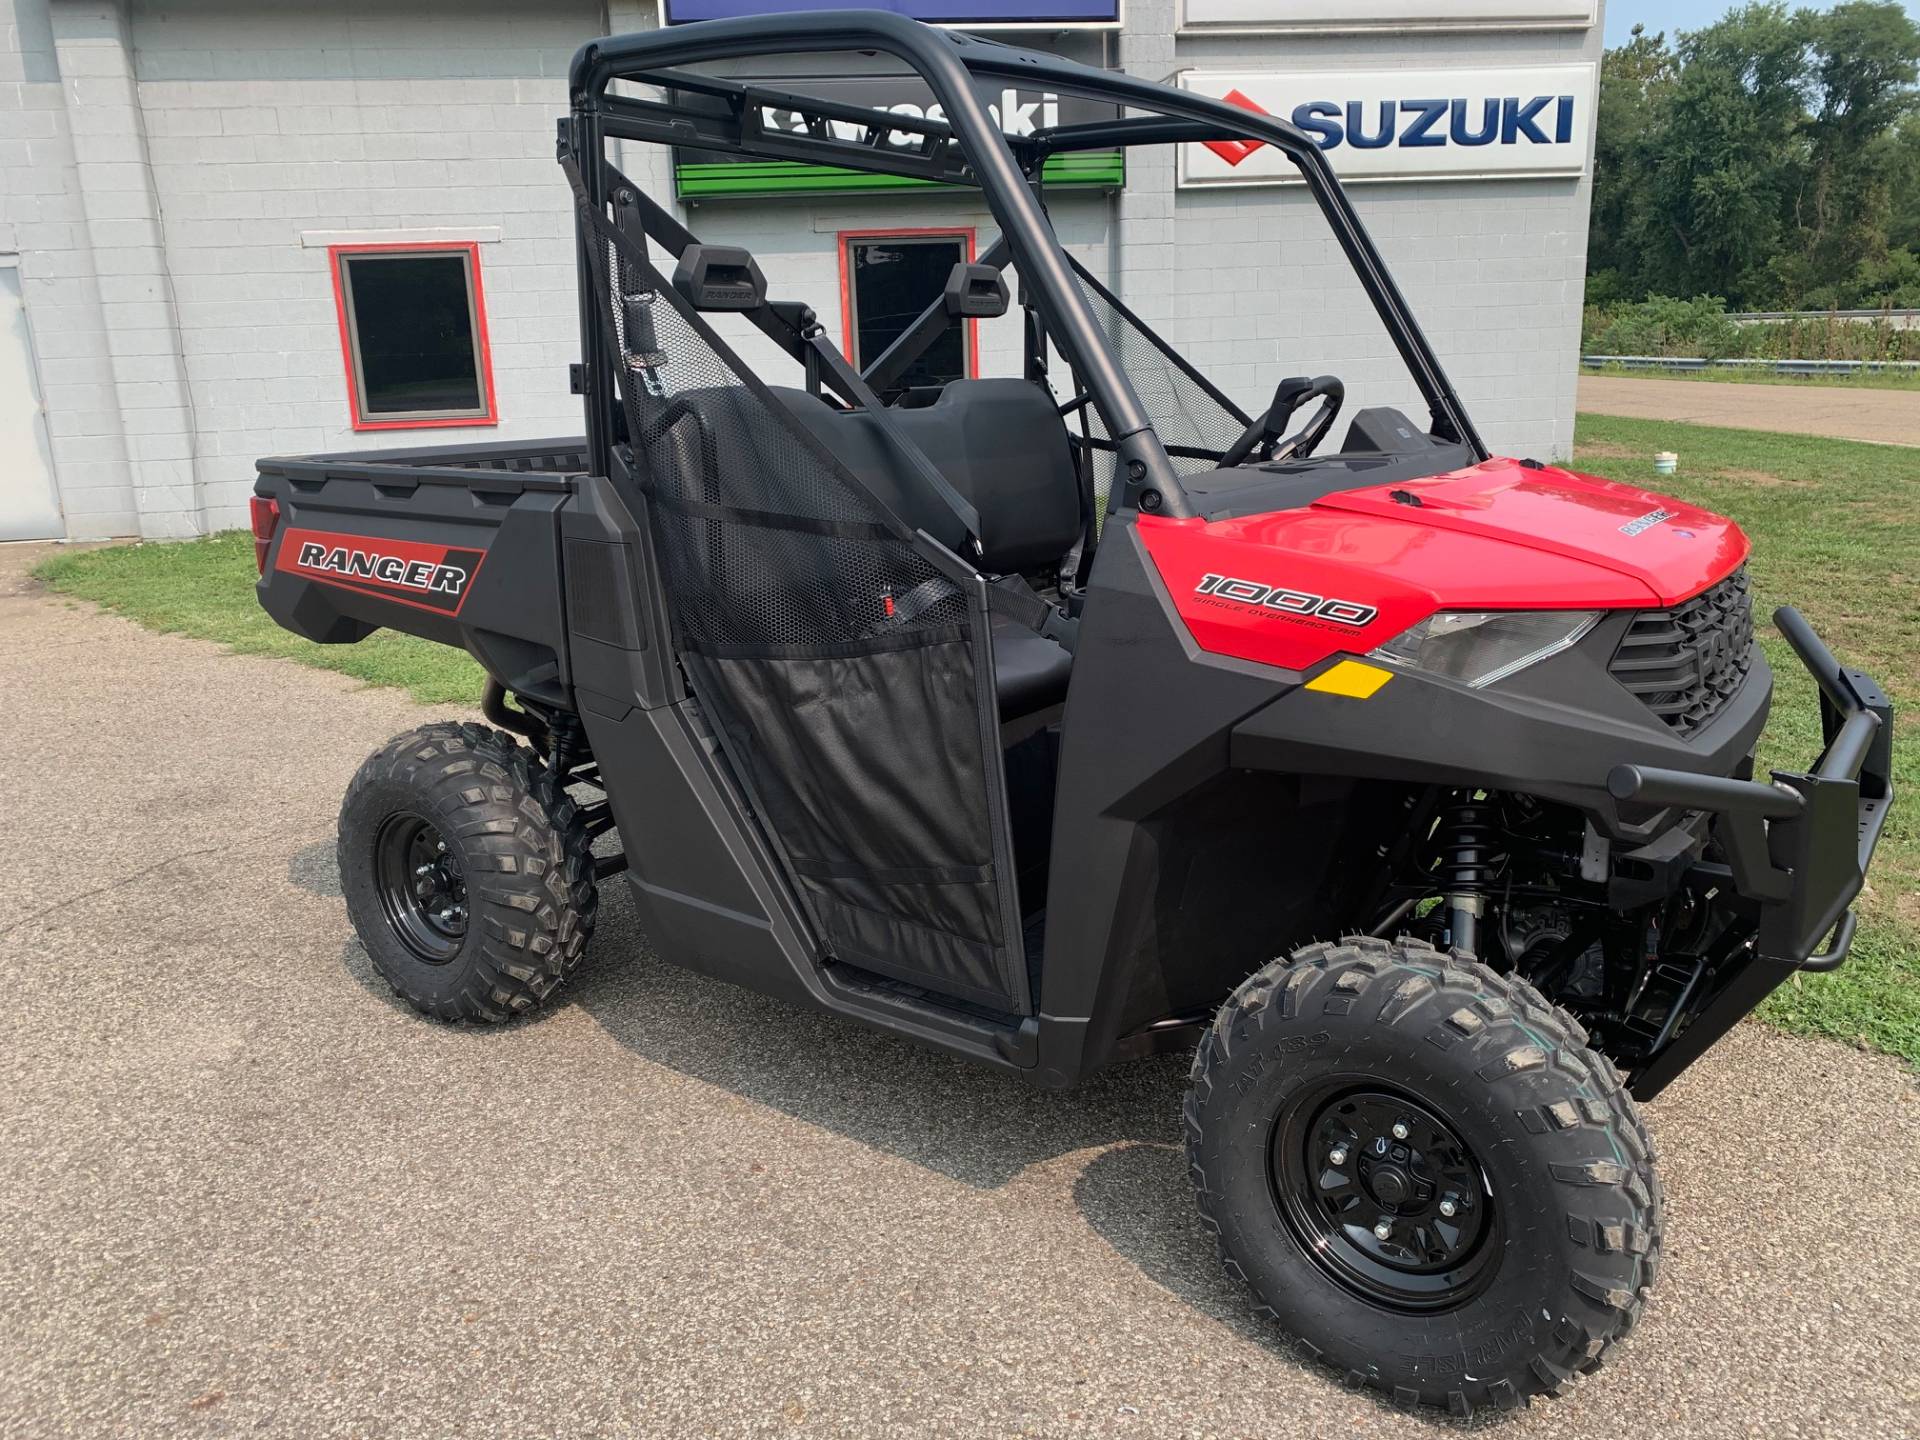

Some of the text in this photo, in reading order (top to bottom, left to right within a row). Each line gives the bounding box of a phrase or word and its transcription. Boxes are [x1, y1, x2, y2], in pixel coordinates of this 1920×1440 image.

[1292, 95, 1575, 150] SUZUKI
[705, 290, 753, 300] RANGER
[298, 542, 466, 594] RANGER
[1192, 597, 1245, 612] SINGLE
[1247, 609, 1328, 630] OVERHEAD
[1194, 573, 1379, 627] 1000
